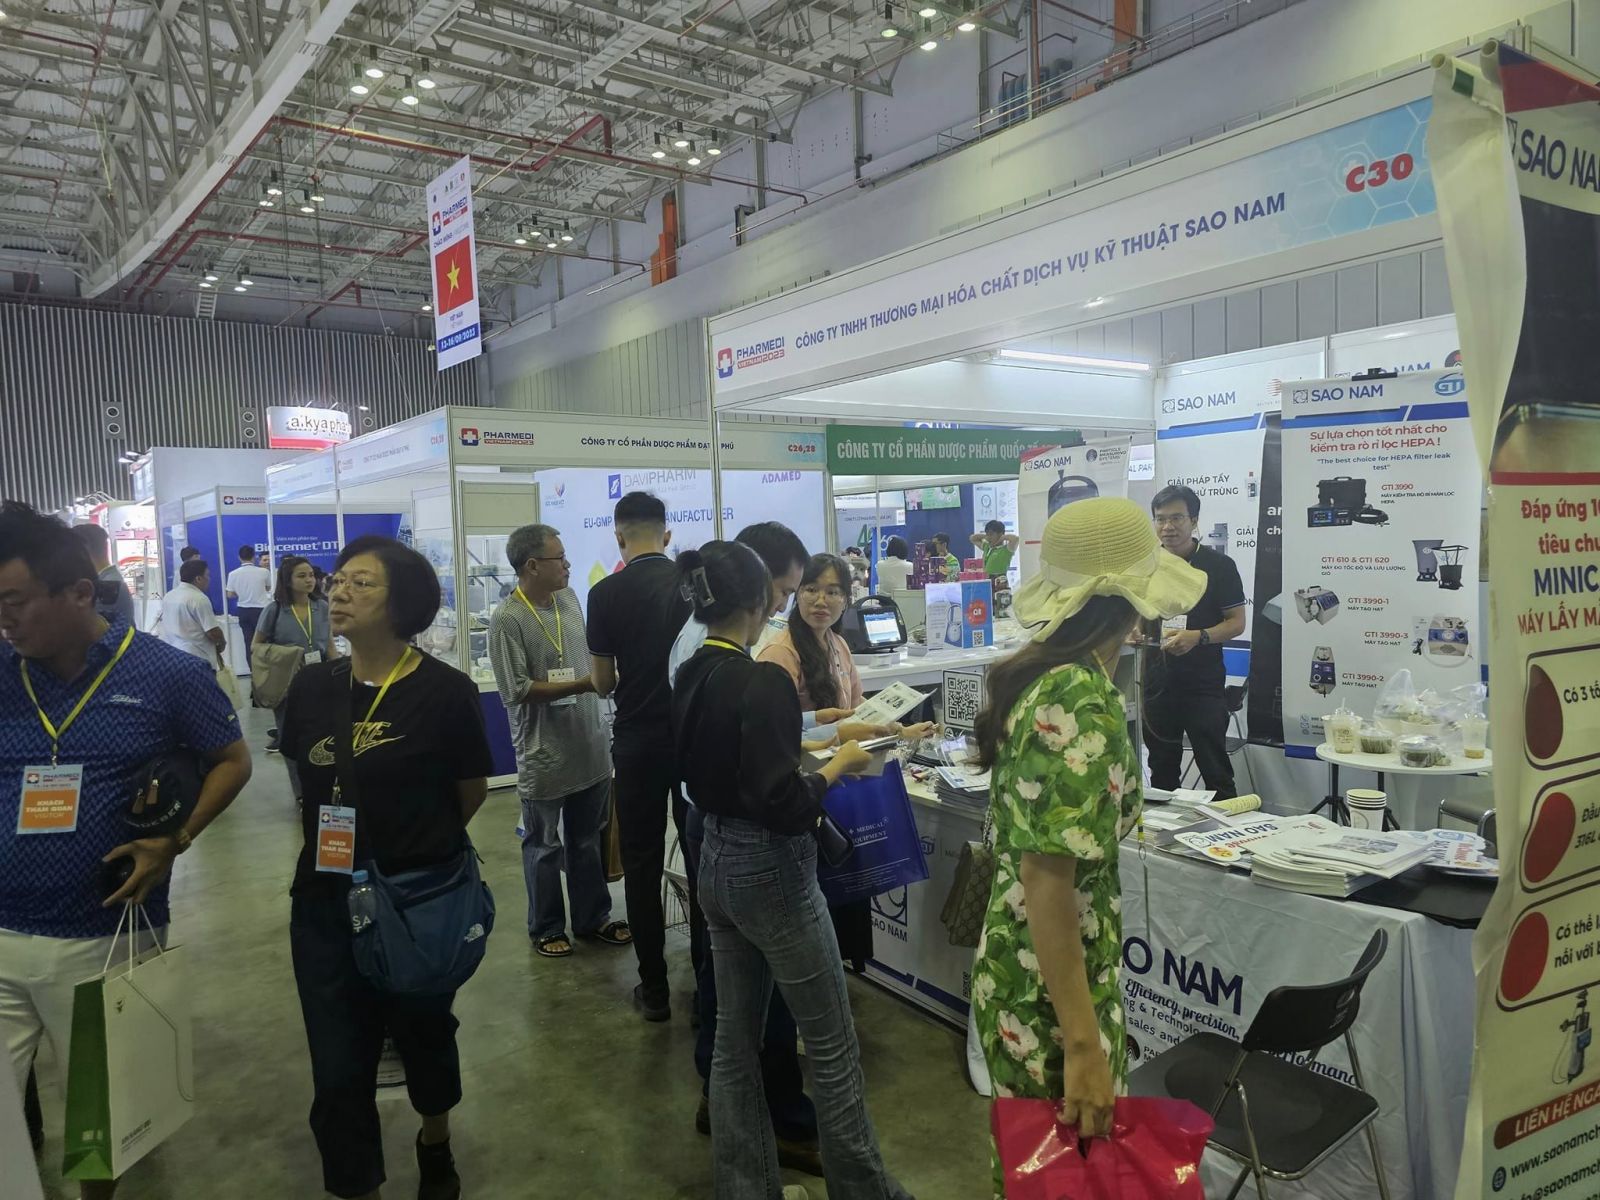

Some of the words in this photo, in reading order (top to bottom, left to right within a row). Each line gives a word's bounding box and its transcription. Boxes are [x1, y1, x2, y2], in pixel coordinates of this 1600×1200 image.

[1518, 129, 1567, 180] SAO
[1569, 146, 1600, 193] NA
[1345, 153, 1414, 193] C30
[796, 331, 825, 350] CÔNG
[827, 325, 838, 341] TY
[840, 317, 867, 337] TNHH
[870, 303, 917, 329] THƯƠNG
[920, 294, 944, 314] MẠI
[948, 283, 977, 306] HÓA
[981, 266, 1020, 296] CHẤT
[1023, 259, 1062, 286] DỊCH
[1067, 251, 1089, 272] VỤ
[1095, 239, 1116, 264] KỸ
[1121, 222, 1179, 256] THUẬT
[1185, 211, 1227, 238] SAO
[1234, 192, 1285, 224] NAM
[736, 336, 785, 360] PHARMEDI
[1177, 396, 1204, 411] SAO
[1207, 391, 1236, 407] NAM
[1311, 388, 1344, 402] SAO
[1349, 384, 1383, 399] NAM
[484, 431, 534, 440] PHARMEDI
[1310, 431, 1326, 440] Sự
[1327, 430, 1344, 442] lựa
[1345, 428, 1374, 439] chọn
[1376, 425, 1393, 436] tốt
[1397, 423, 1423, 435] nhất
[1425, 423, 1448, 433] cho
[581, 437, 605, 446] CÔNG
[607, 438, 615, 447] TY
[631, 437, 651, 448] PHẦN
[653, 440, 675, 449] DƯỢC
[837, 439, 869, 459] CÔNG
[872, 442, 885, 459] TY
[888, 437, 903, 459] CỔ
[906, 438, 936, 460] PHẦN
[938, 442, 965, 462] DƯỢC
[968, 438, 997, 460] PHẨM
[1310, 441, 1338, 453] kiểm
[1340, 442, 1356, 451] tra
[1358, 440, 1369, 450] rò
[1382, 440, 1398, 451] lọc
[1401, 438, 1435, 448] HEPA
[1033, 458, 1051, 469] SAO
[1054, 456, 1072, 467] NAM
[624, 469, 696, 487] DAVIPHARM
[761, 470, 801, 484] ADAMED
[1187, 475, 1210, 486] PHÁP
[1208, 486, 1239, 496] TRÙNG
[584, 516, 612, 529] EU-GMP
[665, 507, 734, 523] ANUFACTUER
[1521, 498, 1551, 523] Đáp
[1556, 497, 1587, 522] ứng
[1591, 498, 1600, 517] 1
[255, 542, 318, 553] Bicemet
[1538, 533, 1570, 555] tiêu
[1533, 564, 1600, 598] MINIC
[1518, 608, 1544, 636] MÁY
[1549, 601, 1579, 631] LẤY
[1584, 598, 1600, 627] M
[1380, 631, 1409, 639] 3990-3
[1357, 674, 1384, 682] 3990-2
[1563, 687, 1579, 704] Có
[1580, 685, 1588, 701] 3
[856, 821, 885, 833] MEDICAL
[1206, 829, 1246, 843] NAM
[1244, 823, 1278, 834] SAO
[888, 924, 908, 943] NAM
[1556, 923, 1571, 940] Có
[1574, 913, 1593, 936] thể
[1554, 947, 1573, 968] nối
[1576, 942, 1594, 961] với
[1163, 947, 1243, 1016] NAM
[1140, 1002, 1147, 1013] &
[1128, 1016, 1156, 1036] sales
[1160, 1030, 1181, 1046] and
[1515, 1107, 1550, 1137] LIÊN
[1552, 1093, 1573, 1120] HỆ
